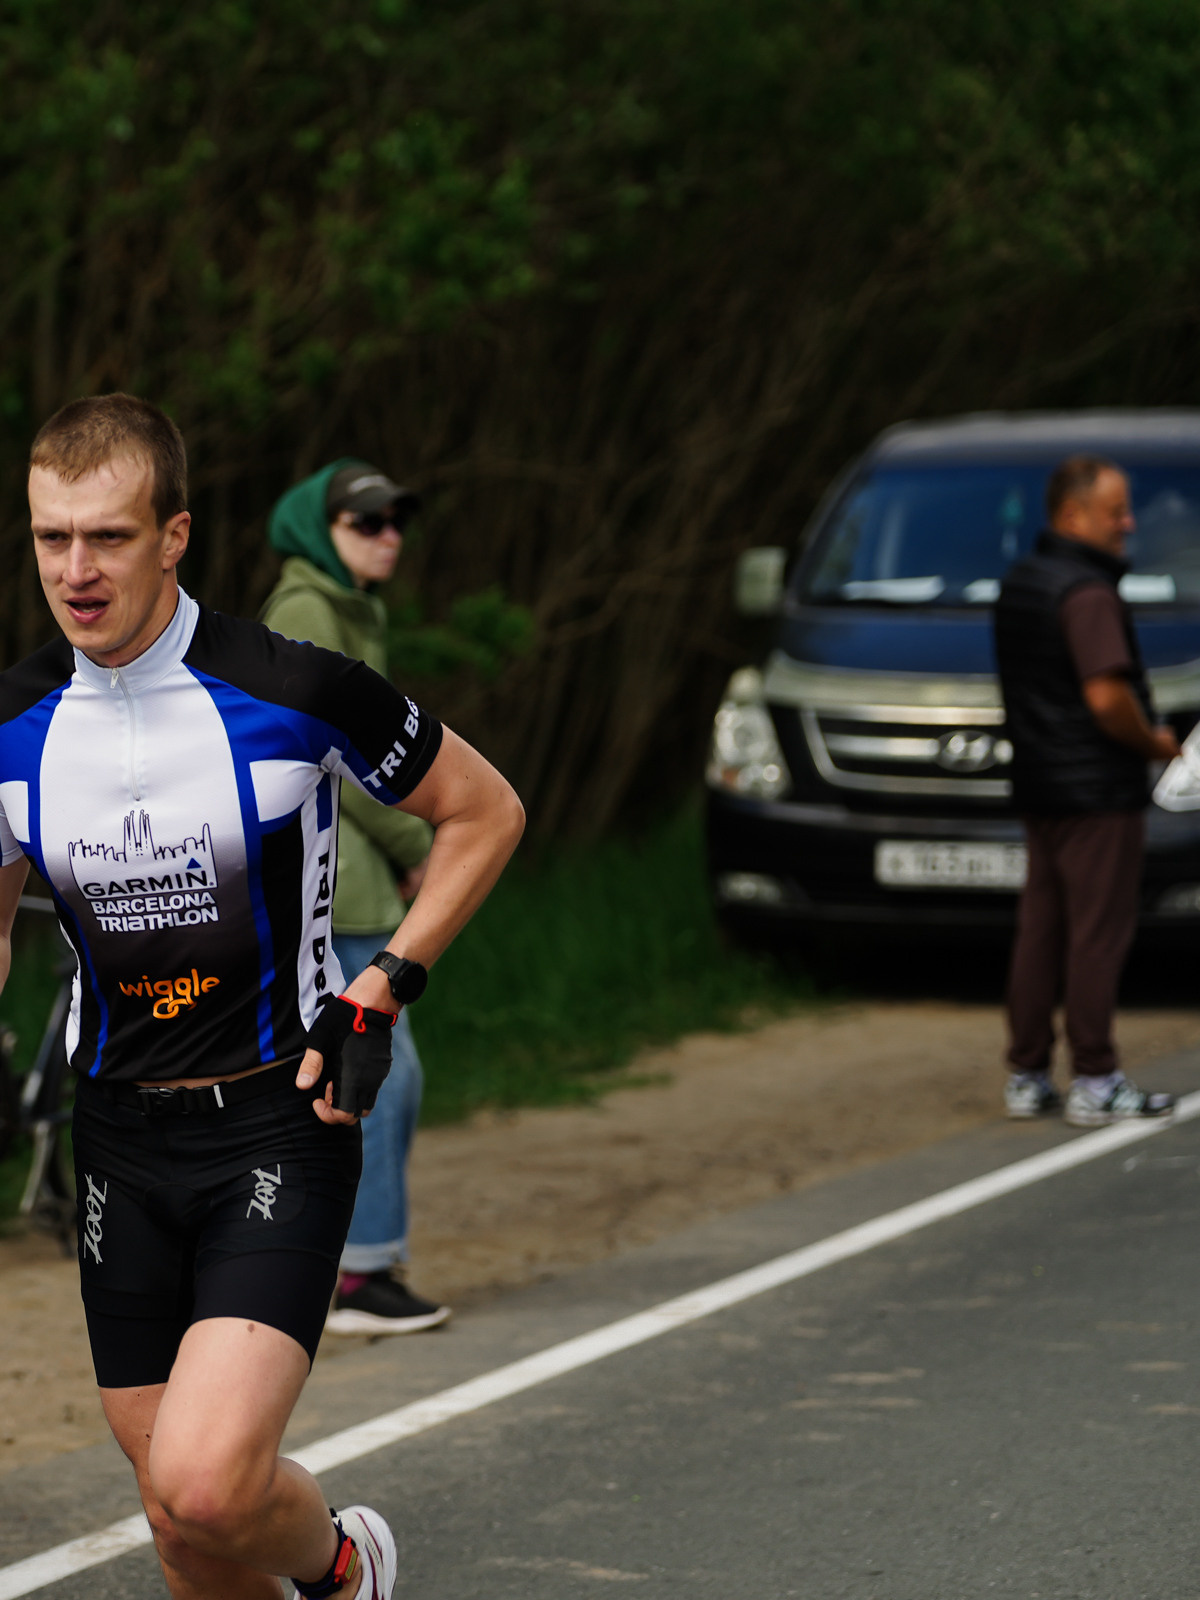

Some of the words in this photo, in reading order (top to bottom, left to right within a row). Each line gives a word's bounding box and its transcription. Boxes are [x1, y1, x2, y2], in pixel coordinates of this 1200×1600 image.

[362, 740, 407, 789] TRI
[91, 892, 216, 914] BARCELONA
[119, 968, 220, 1019] wiggle
